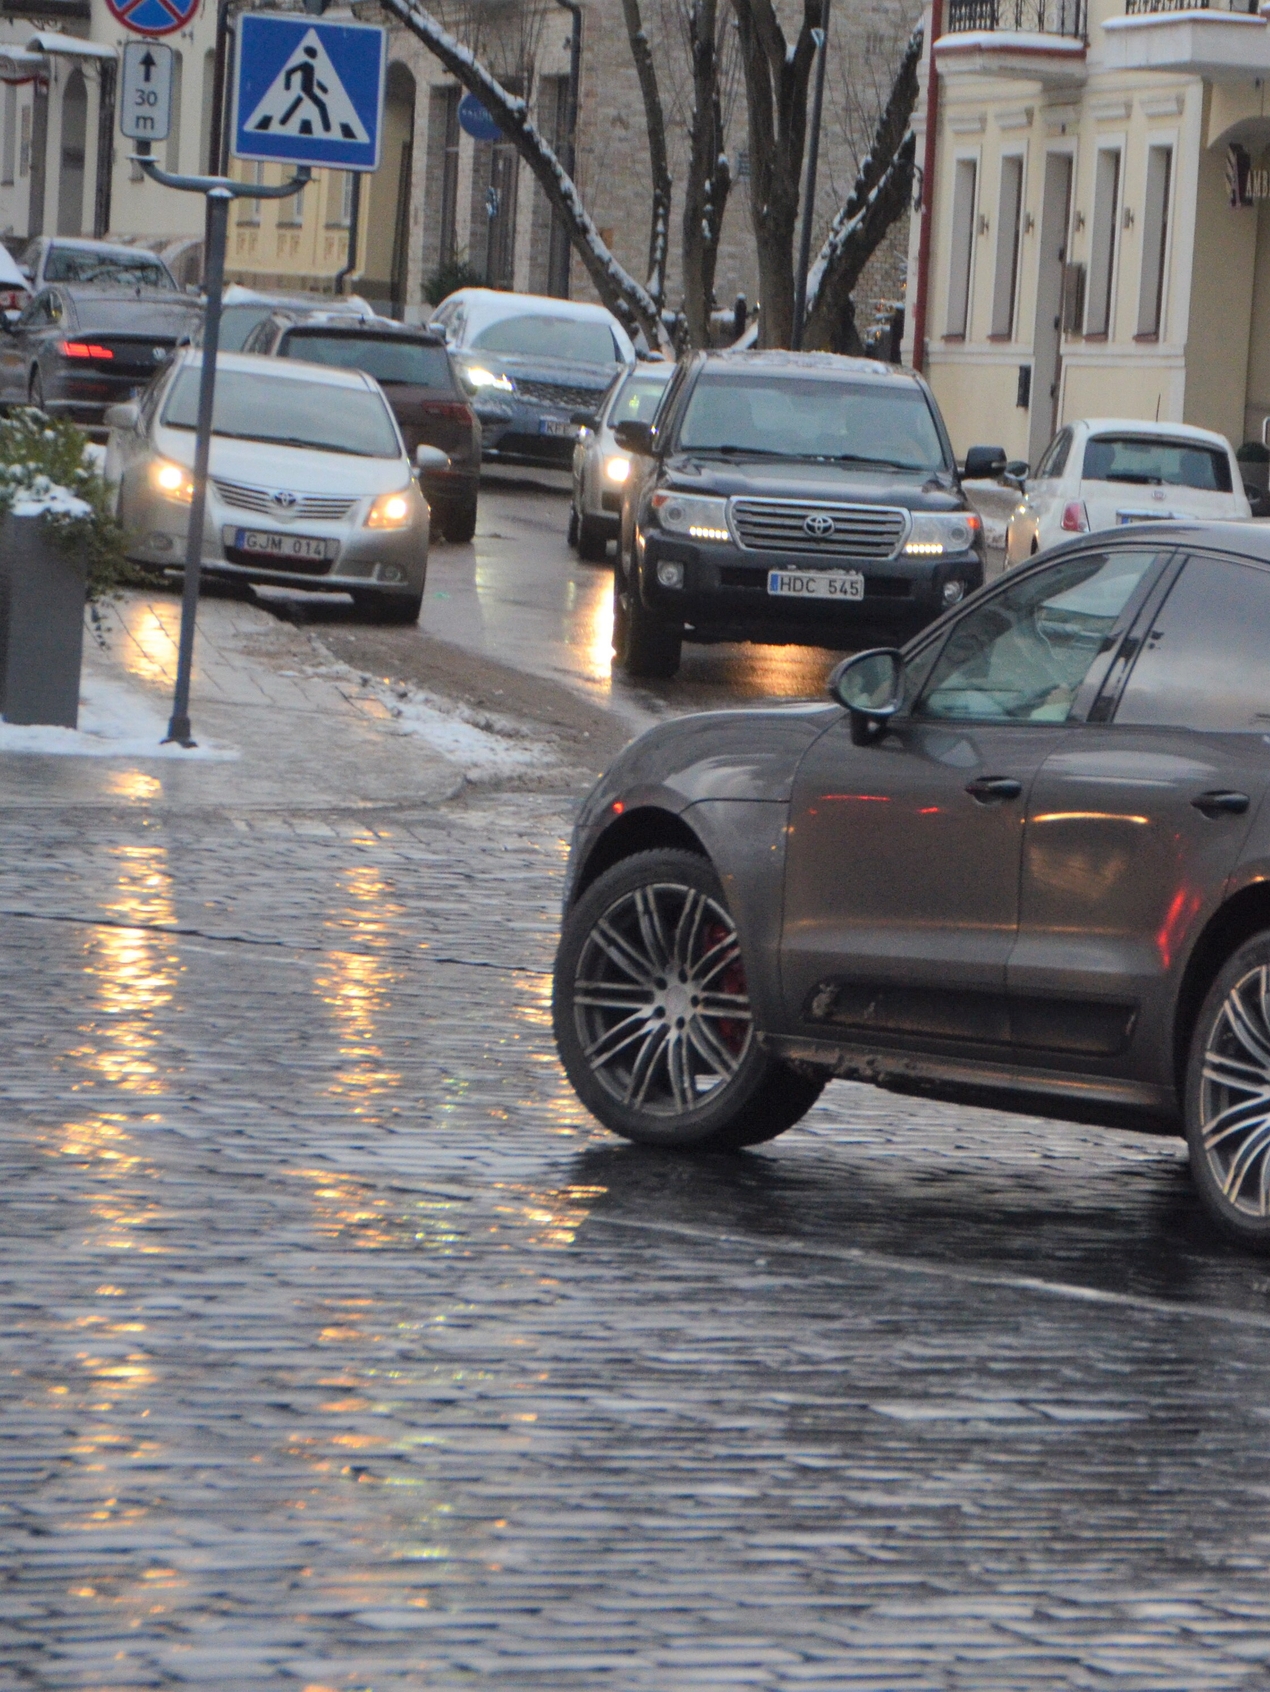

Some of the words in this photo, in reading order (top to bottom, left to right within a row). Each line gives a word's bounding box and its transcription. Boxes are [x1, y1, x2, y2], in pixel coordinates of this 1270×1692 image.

[135, 89, 158, 106] 30
[135, 115, 155, 130] m
[246, 534, 282, 551] GJM
[293, 541, 321, 556] 014
[780, 577, 816, 594] HDC
[828, 580, 859, 596] 545
